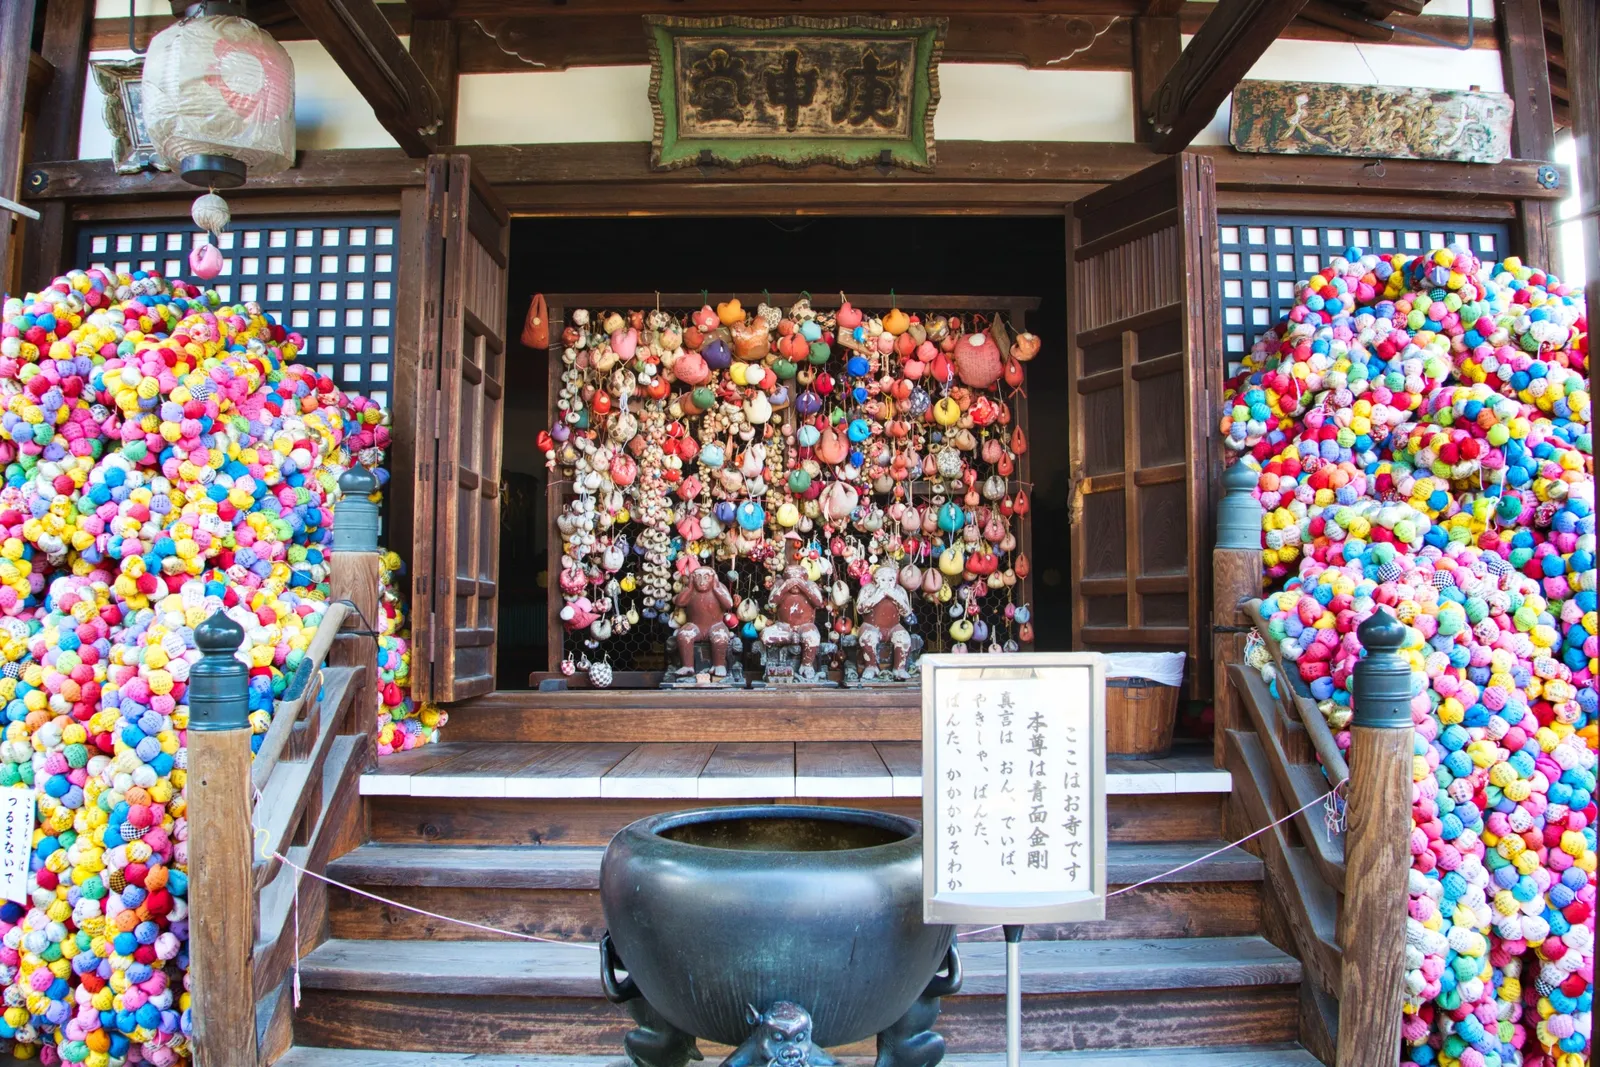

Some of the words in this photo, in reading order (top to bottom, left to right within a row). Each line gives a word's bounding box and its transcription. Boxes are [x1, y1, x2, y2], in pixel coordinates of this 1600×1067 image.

[997, 691, 1016, 745] 真言は
[4, 796, 18, 885] つるさないで
[1026, 711, 1050, 870] 本尊は青面金剛
[1061, 726, 1083, 883] ここはお寺です
